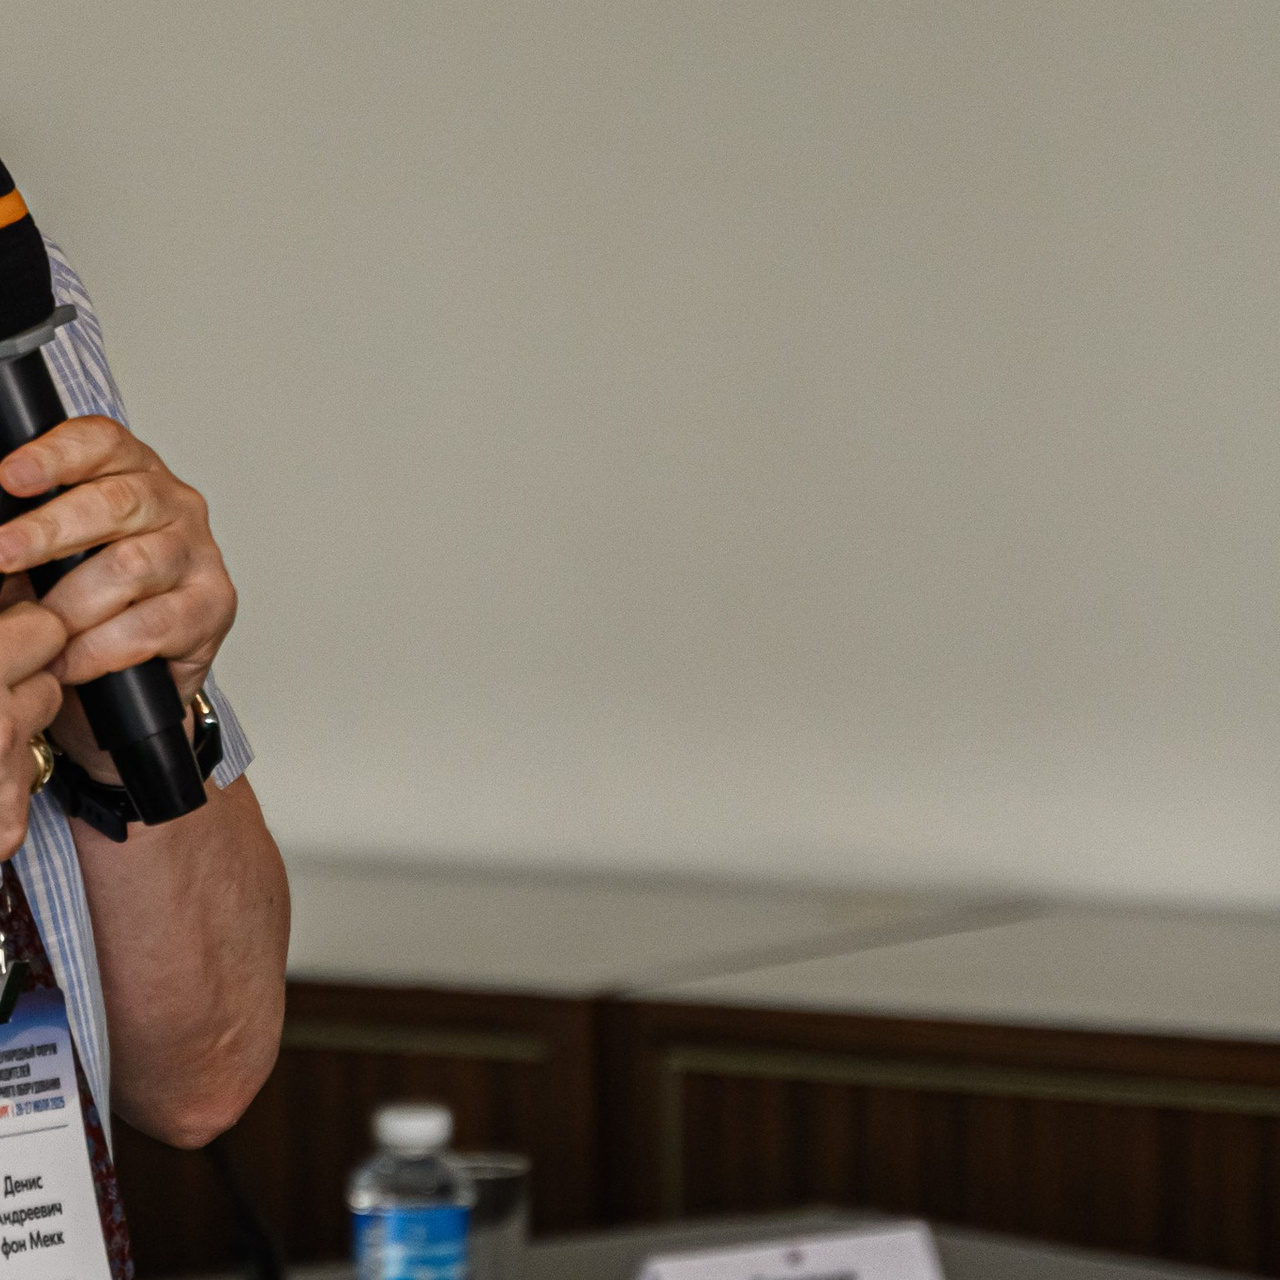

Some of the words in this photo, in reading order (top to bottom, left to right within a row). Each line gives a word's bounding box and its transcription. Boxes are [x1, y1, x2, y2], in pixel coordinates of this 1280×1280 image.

[4, 1175, 43, 1198] Денис
[1, 1236, 27, 1260] фон
[29, 1230, 65, 1250] Мекк
